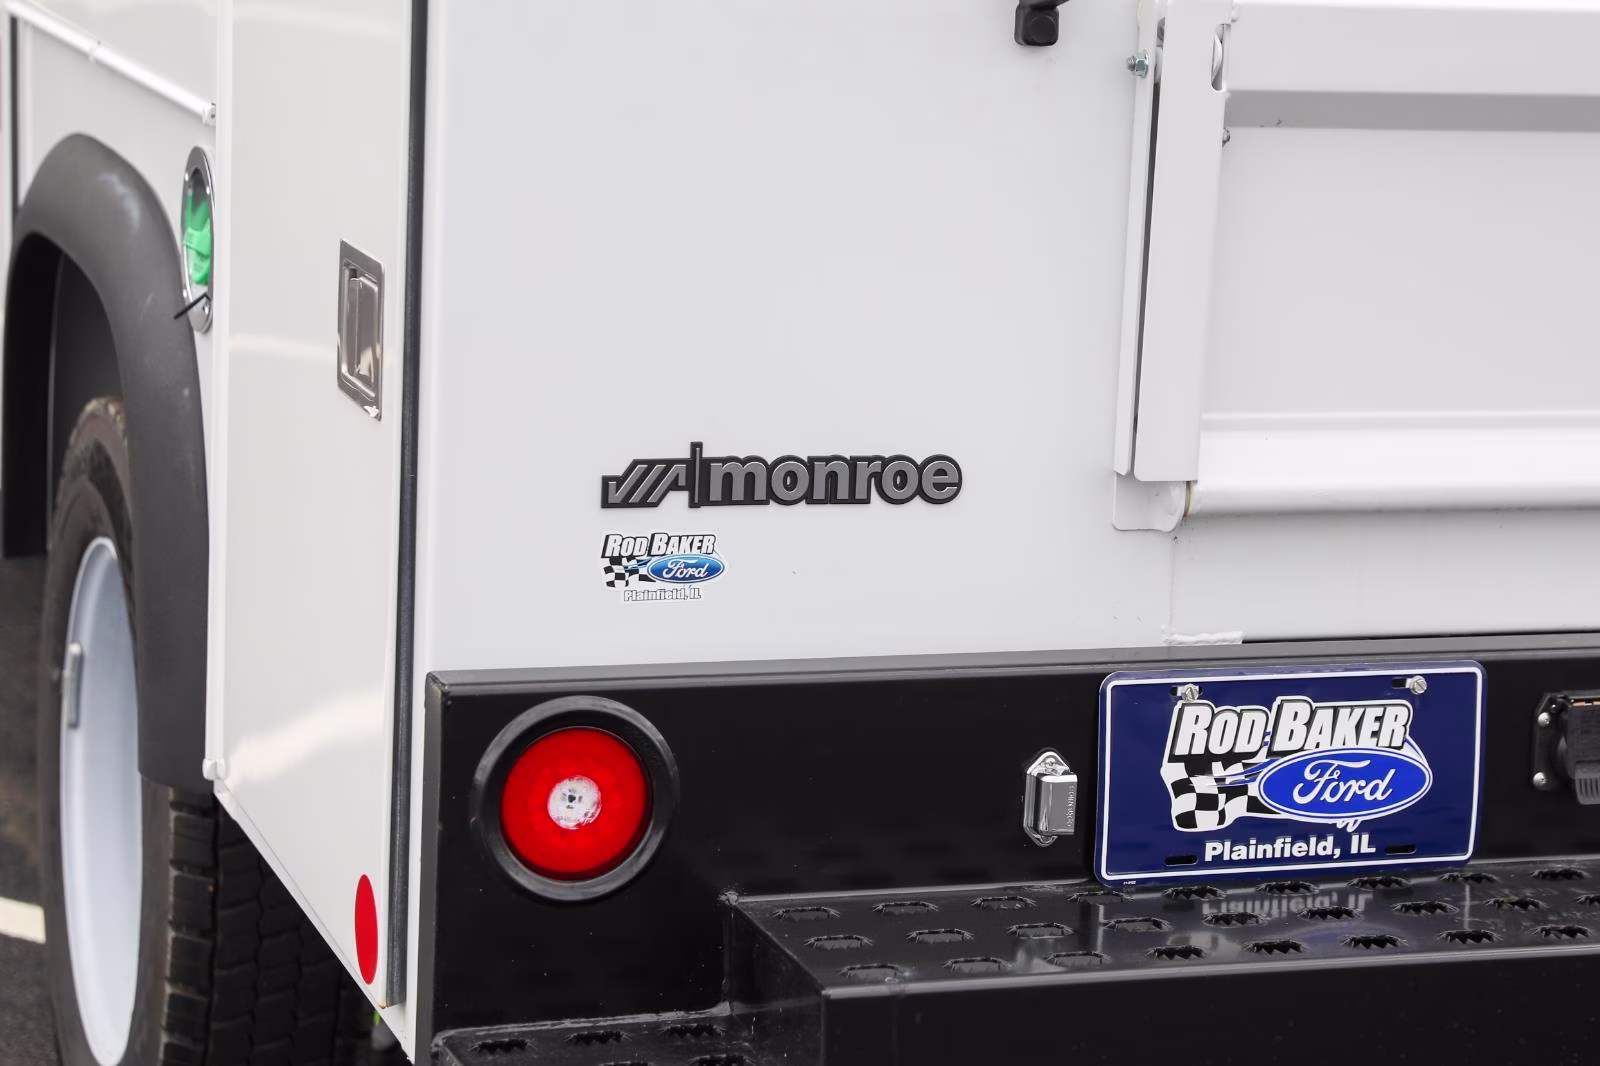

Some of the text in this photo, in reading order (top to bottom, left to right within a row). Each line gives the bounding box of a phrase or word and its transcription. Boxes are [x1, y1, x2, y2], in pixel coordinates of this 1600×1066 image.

[707, 458, 961, 503] monroe
[602, 532, 716, 557] ROD BAKER
[662, 559, 708, 579] Ford
[624, 587, 702, 601] Plainfield, IL
[1173, 698, 1409, 756] ROD BAKER
[1293, 759, 1396, 805] Ford
[1204, 833, 1376, 861] Plainfield, IL
